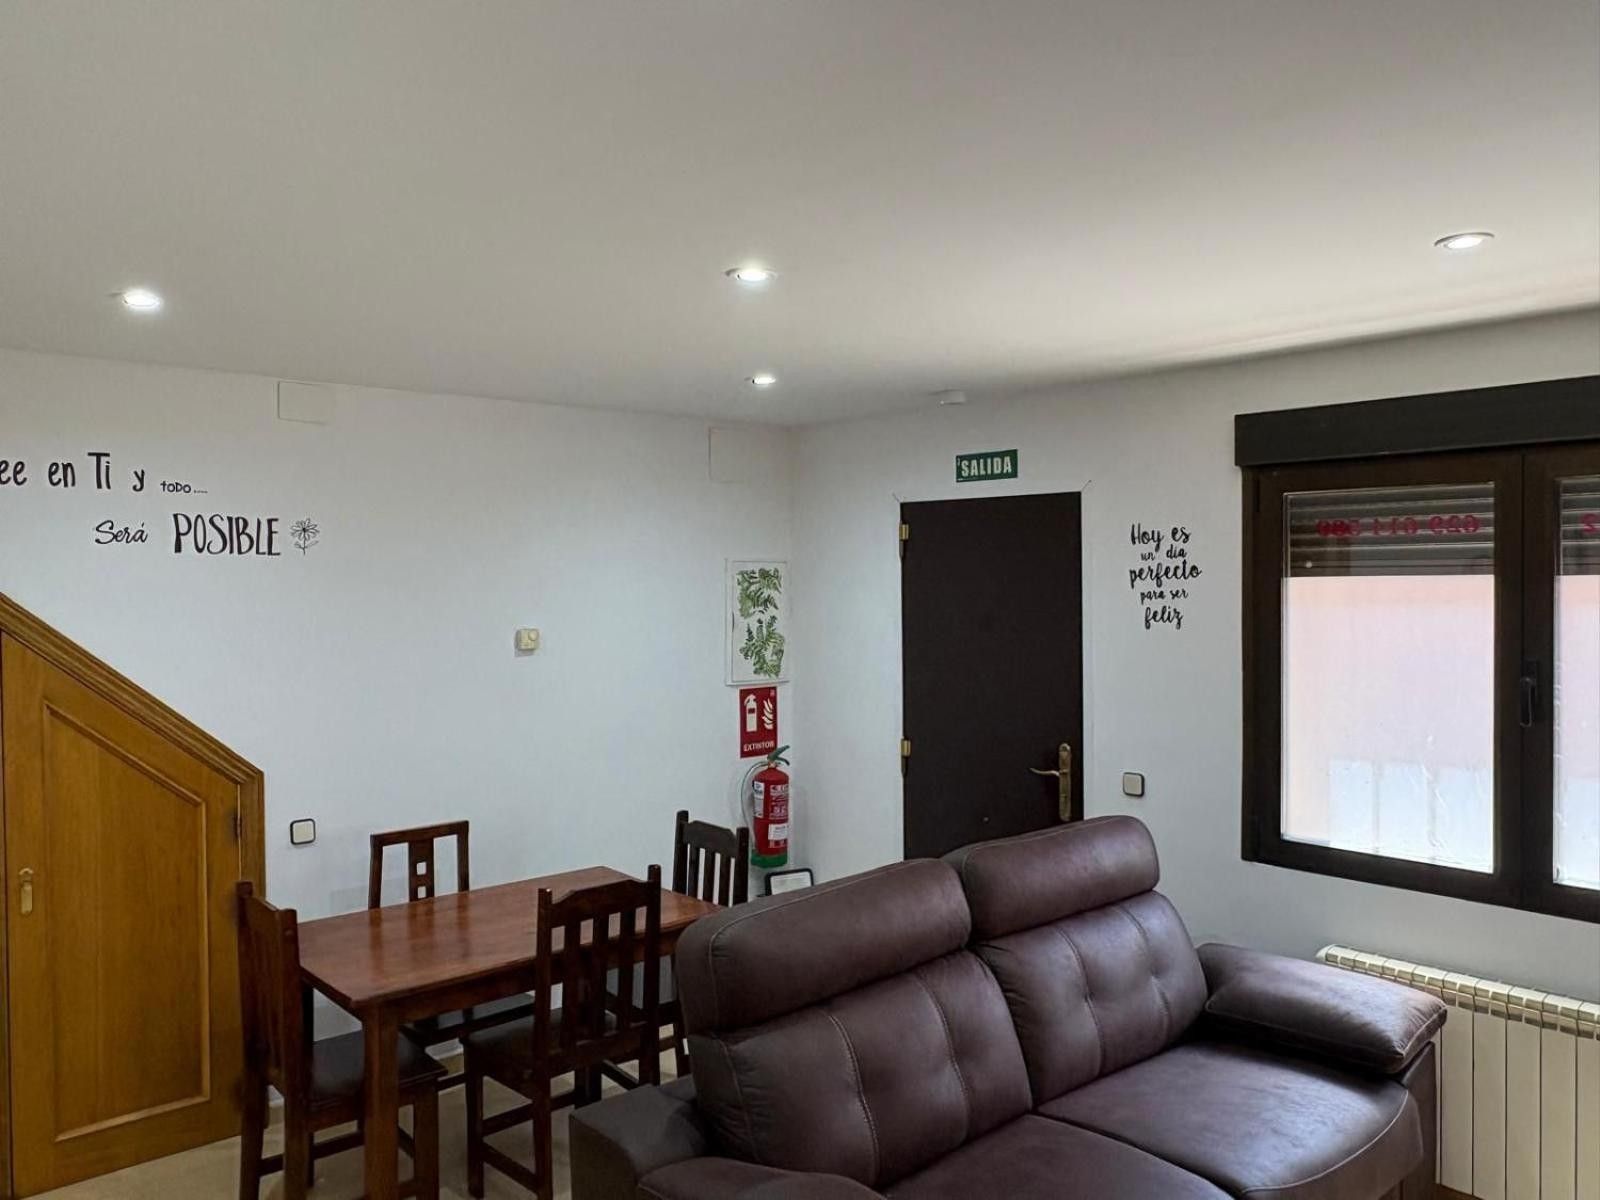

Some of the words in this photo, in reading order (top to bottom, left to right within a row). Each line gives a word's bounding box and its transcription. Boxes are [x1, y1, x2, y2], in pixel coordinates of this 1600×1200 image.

[47, 461, 75, 488] en
[87, 451, 112, 490] Ti
[132, 468, 146, 493] y
[960, 456, 1012, 477] SALIDA
[94, 519, 149, 545] Será
[172, 512, 281, 556] POSIBLE
[1131, 523, 1164, 553] Hoy
[1171, 527, 1191, 544] es
[1140, 551, 1155, 561] un
[1129, 559, 1203, 590] perfecto
[1140, 590, 1166, 606] para
[1169, 588, 1189, 601] ser
[1144, 605, 1183, 631] feliz
[744, 741, 775, 752] EXTINTOR
